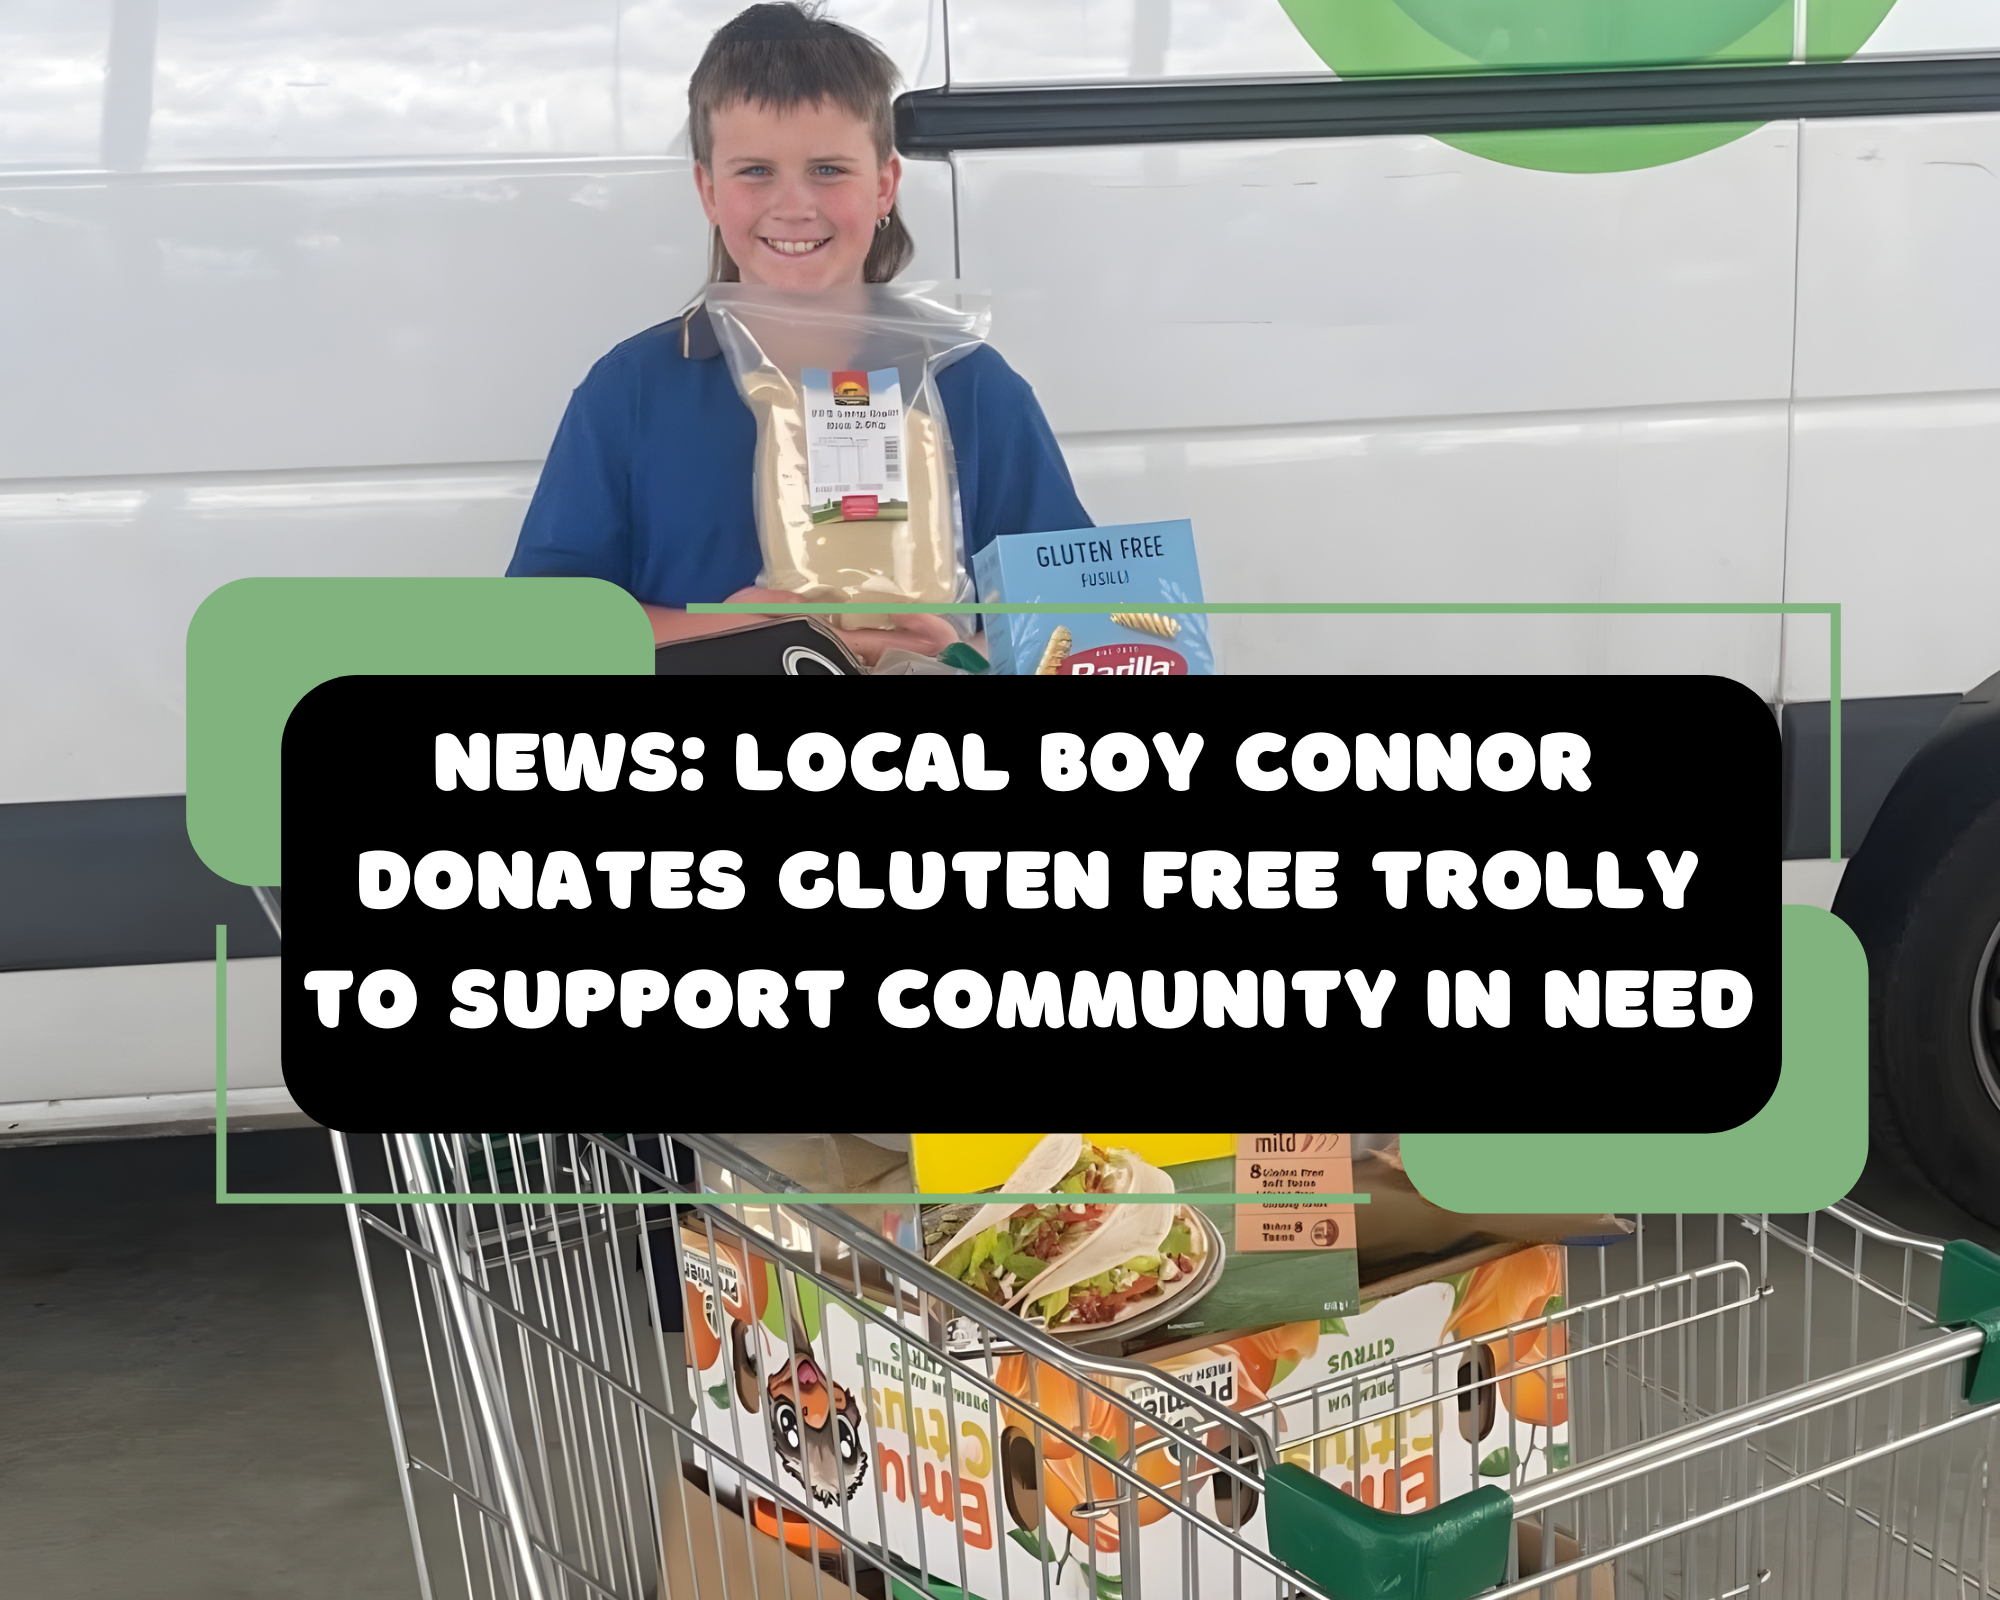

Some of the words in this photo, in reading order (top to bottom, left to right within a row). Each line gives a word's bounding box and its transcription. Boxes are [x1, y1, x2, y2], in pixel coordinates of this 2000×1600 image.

[1036, 539, 1113, 567] GLUTEN
[1120, 535, 1165, 559] FREE
[1255, 1133, 1296, 1153] mild
[1250, 1164, 1262, 1179] 8
[1294, 1221, 1303, 1234] 8
[1327, 1337, 1395, 1375] CITRUS
[1328, 1374, 1396, 1413] PREMUM
